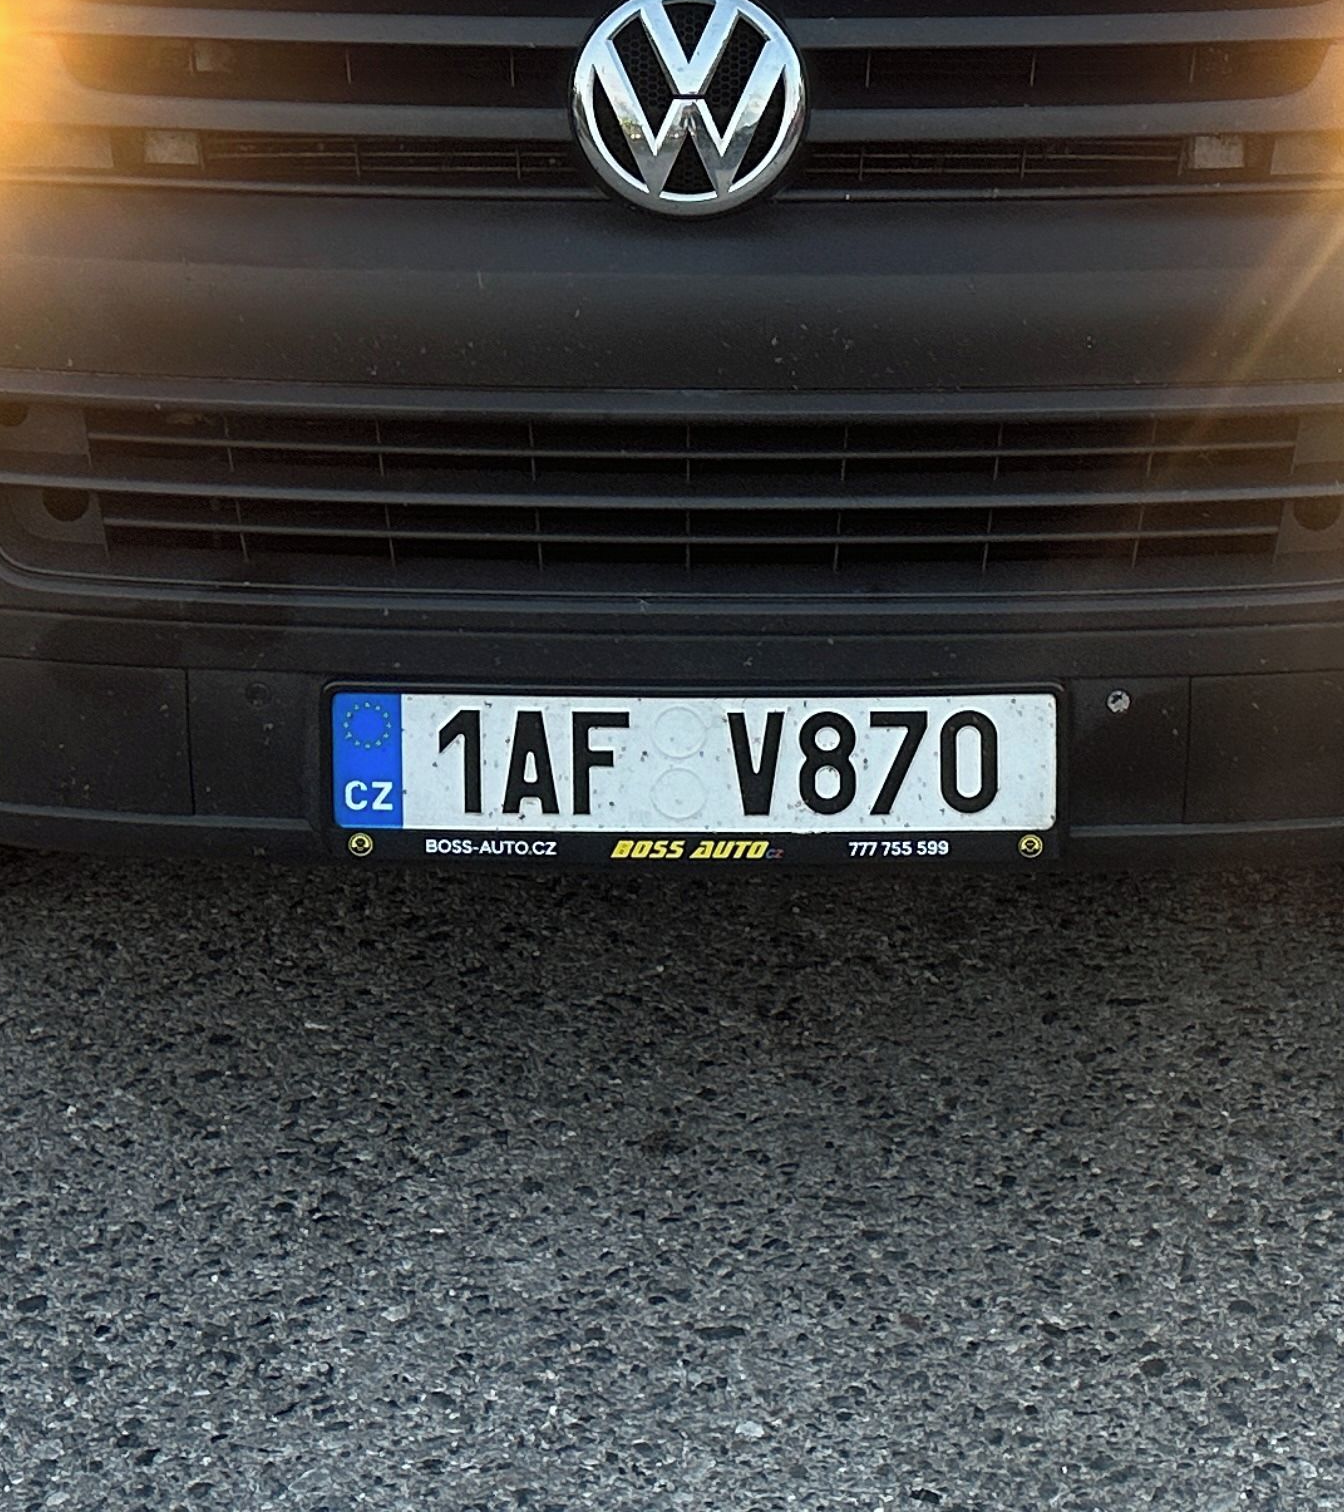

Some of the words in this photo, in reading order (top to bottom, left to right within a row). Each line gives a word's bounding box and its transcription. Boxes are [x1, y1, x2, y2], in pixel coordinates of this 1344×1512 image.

[437, 708, 631, 815] 1AF
[726, 709, 1000, 817] V870
[344, 780, 394, 812] CZ
[425, 839, 557, 856] BOSS-AUTO.CZ
[610, 840, 685, 858] BOSS
[848, 841, 877, 856] 777
[882, 841, 912, 856] 755
[916, 840, 949, 856] 599
